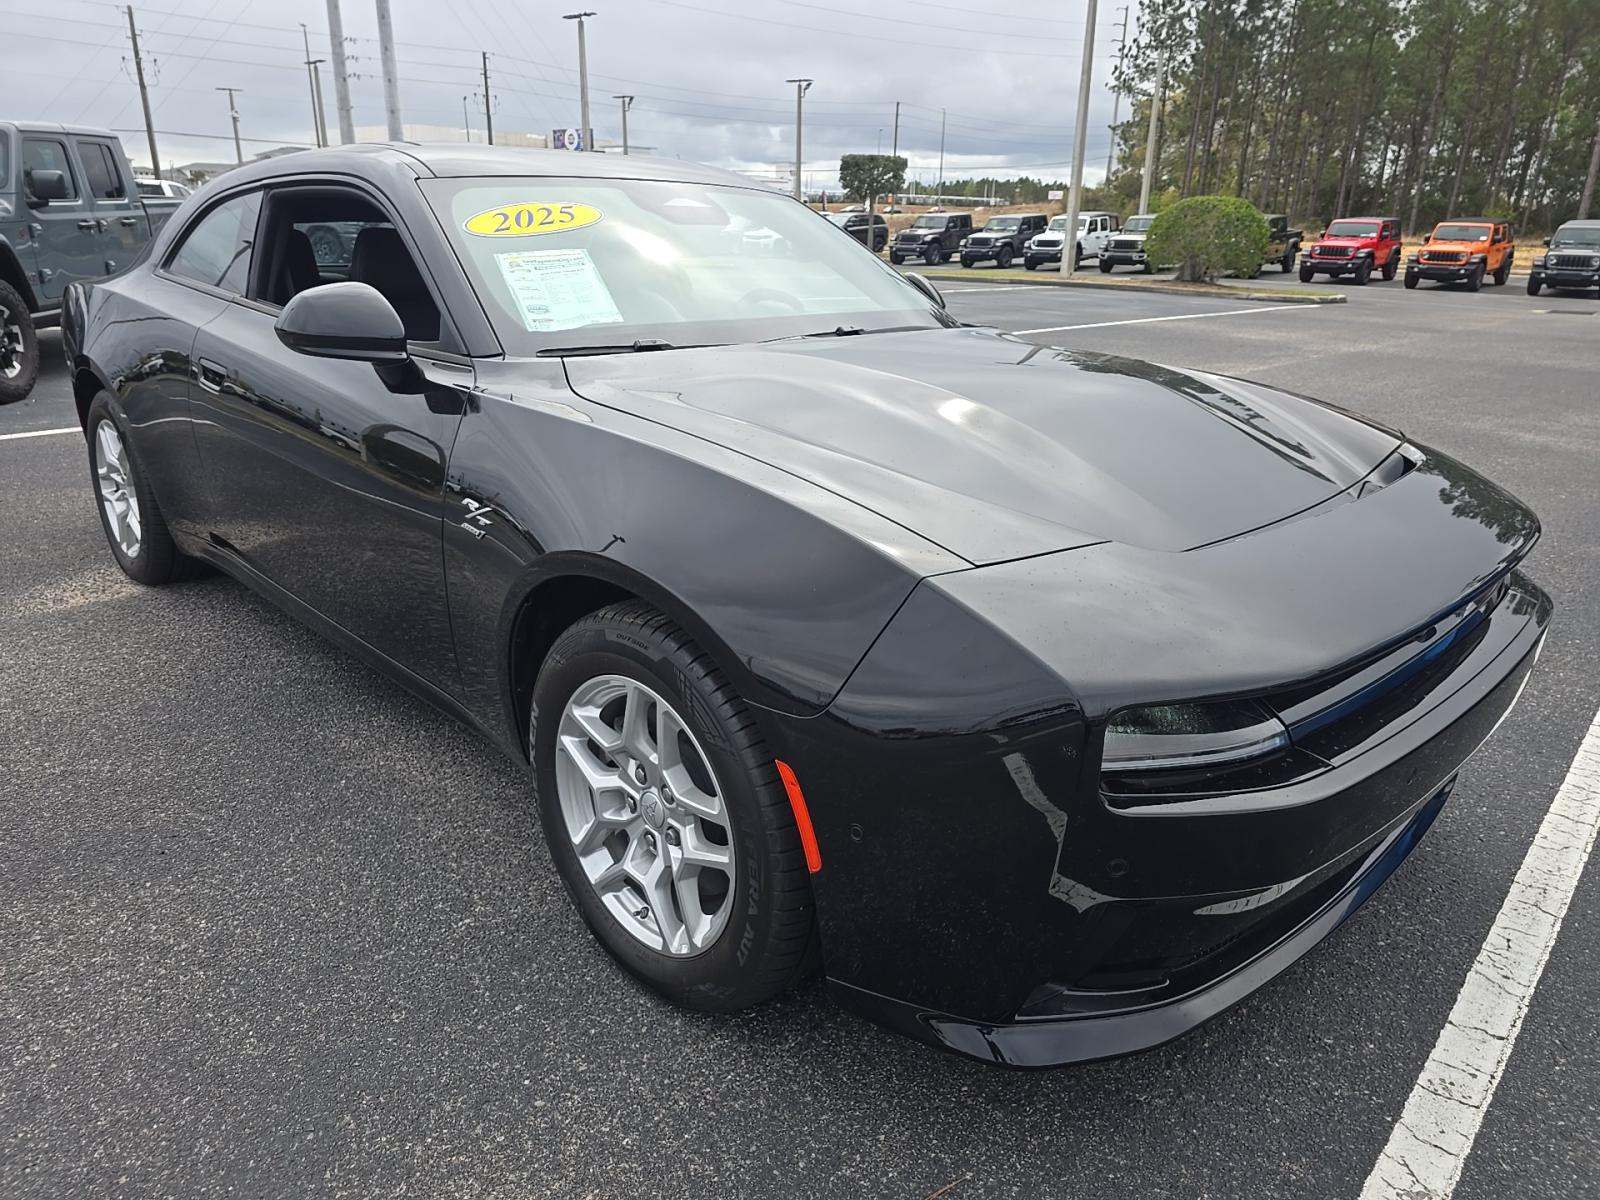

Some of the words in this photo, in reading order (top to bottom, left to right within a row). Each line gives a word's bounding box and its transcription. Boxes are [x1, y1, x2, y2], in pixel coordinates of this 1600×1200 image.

[492, 205, 575, 232] 2025
[460, 497, 493, 526] R/T
[616, 632, 649, 651] OUTSIDE
